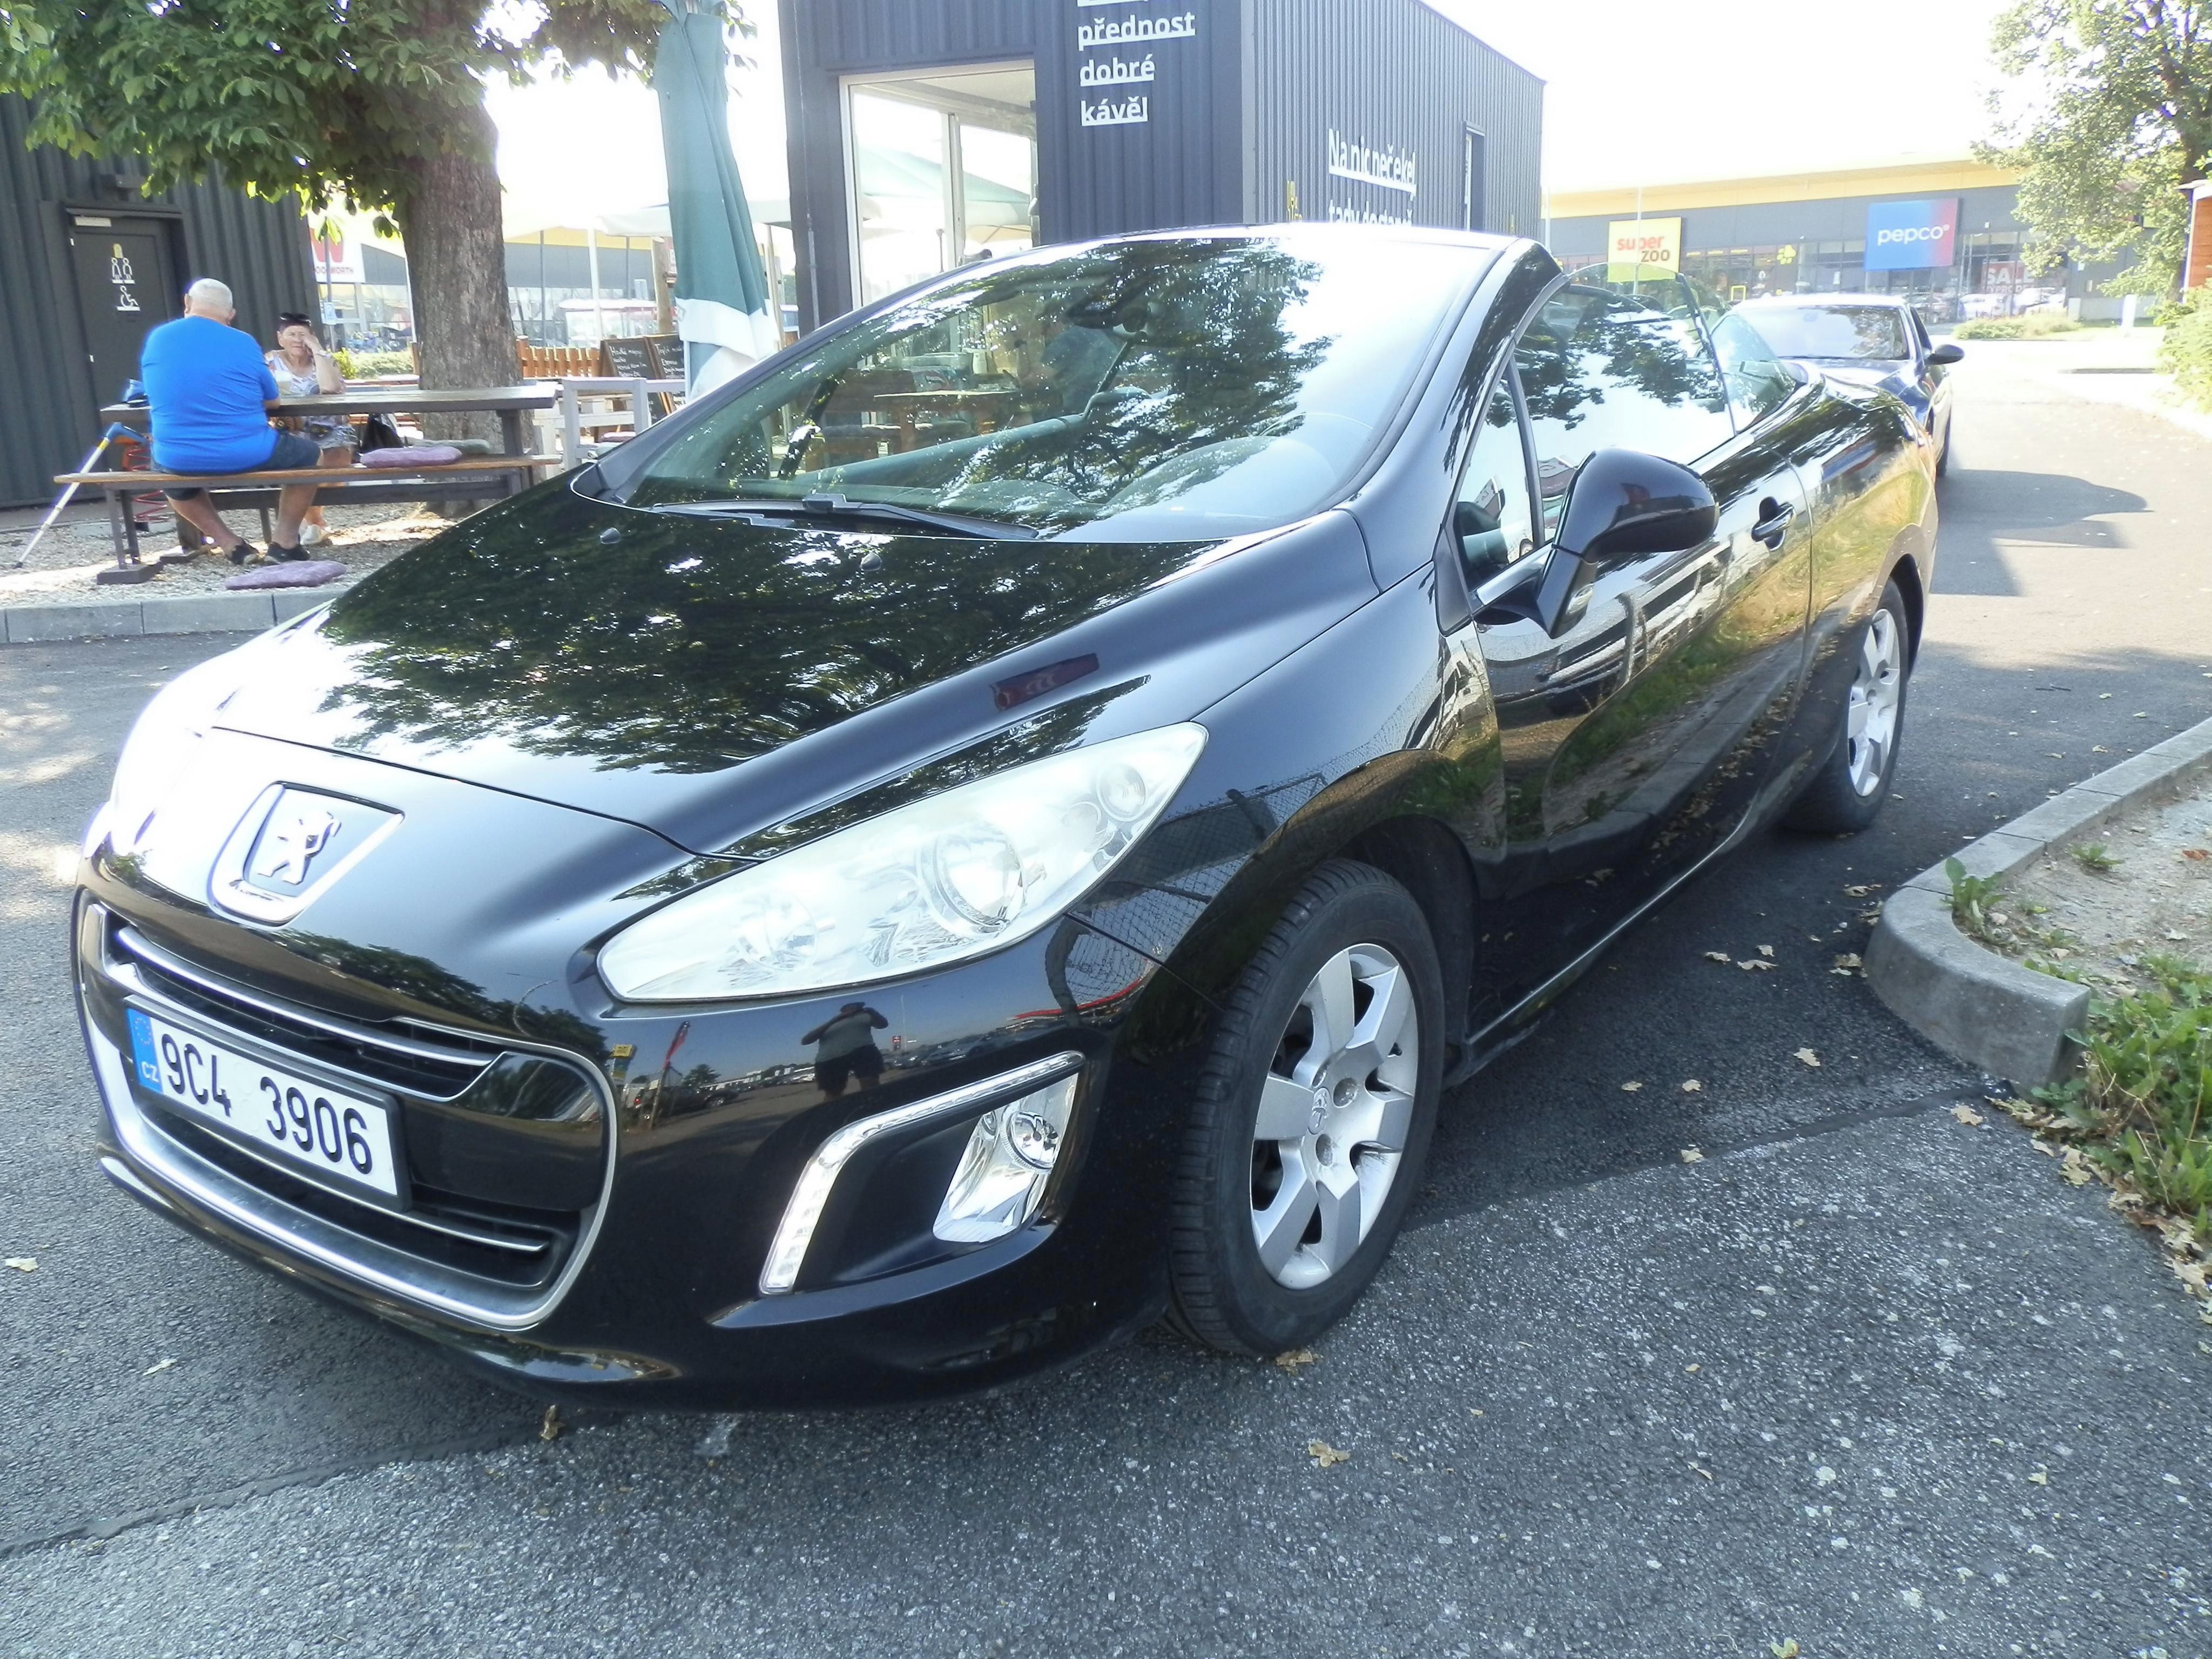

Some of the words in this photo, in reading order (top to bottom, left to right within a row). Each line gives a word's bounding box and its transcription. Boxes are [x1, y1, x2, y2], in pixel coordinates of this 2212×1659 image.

[1078, 12, 1195, 51] přednost
[1080, 54, 1155, 86] dobré
[1328, 128, 1347, 173] Na
[1351, 135, 1370, 177] nic
[1878, 225, 1944, 246] pepco
[141, 1061, 159, 1082] CZ
[161, 1034, 232, 1117] 9C4
[260, 1076, 373, 1175] 3906
